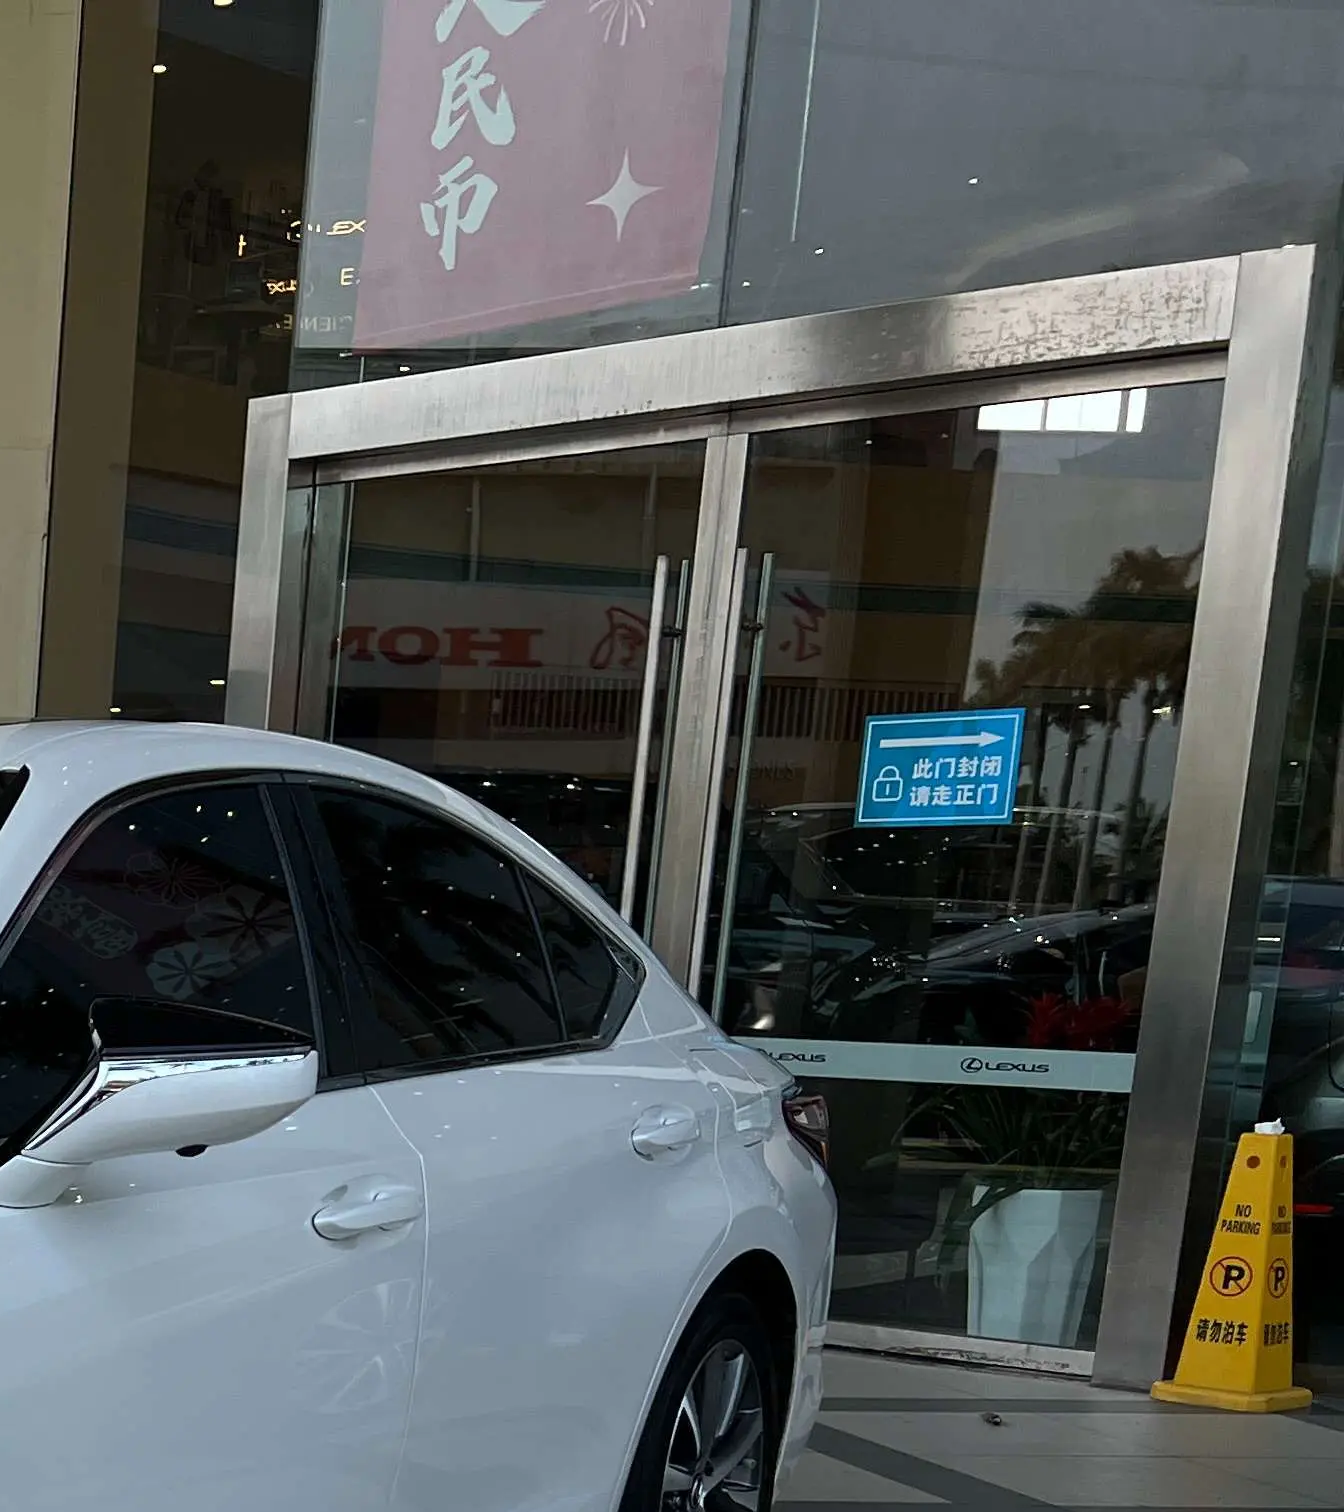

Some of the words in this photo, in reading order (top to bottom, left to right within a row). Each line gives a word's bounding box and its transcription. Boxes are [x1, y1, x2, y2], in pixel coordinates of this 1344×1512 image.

[912, 755, 1003, 781] 此门封闭
[909, 783, 1000, 808] 请走正门
[984, 1061, 1051, 1074] LEXUS
[1234, 1203, 1252, 1218] NO
[1220, 1219, 1261, 1236] PARKING
[1195, 1318, 1249, 1346] 请勿泊车
